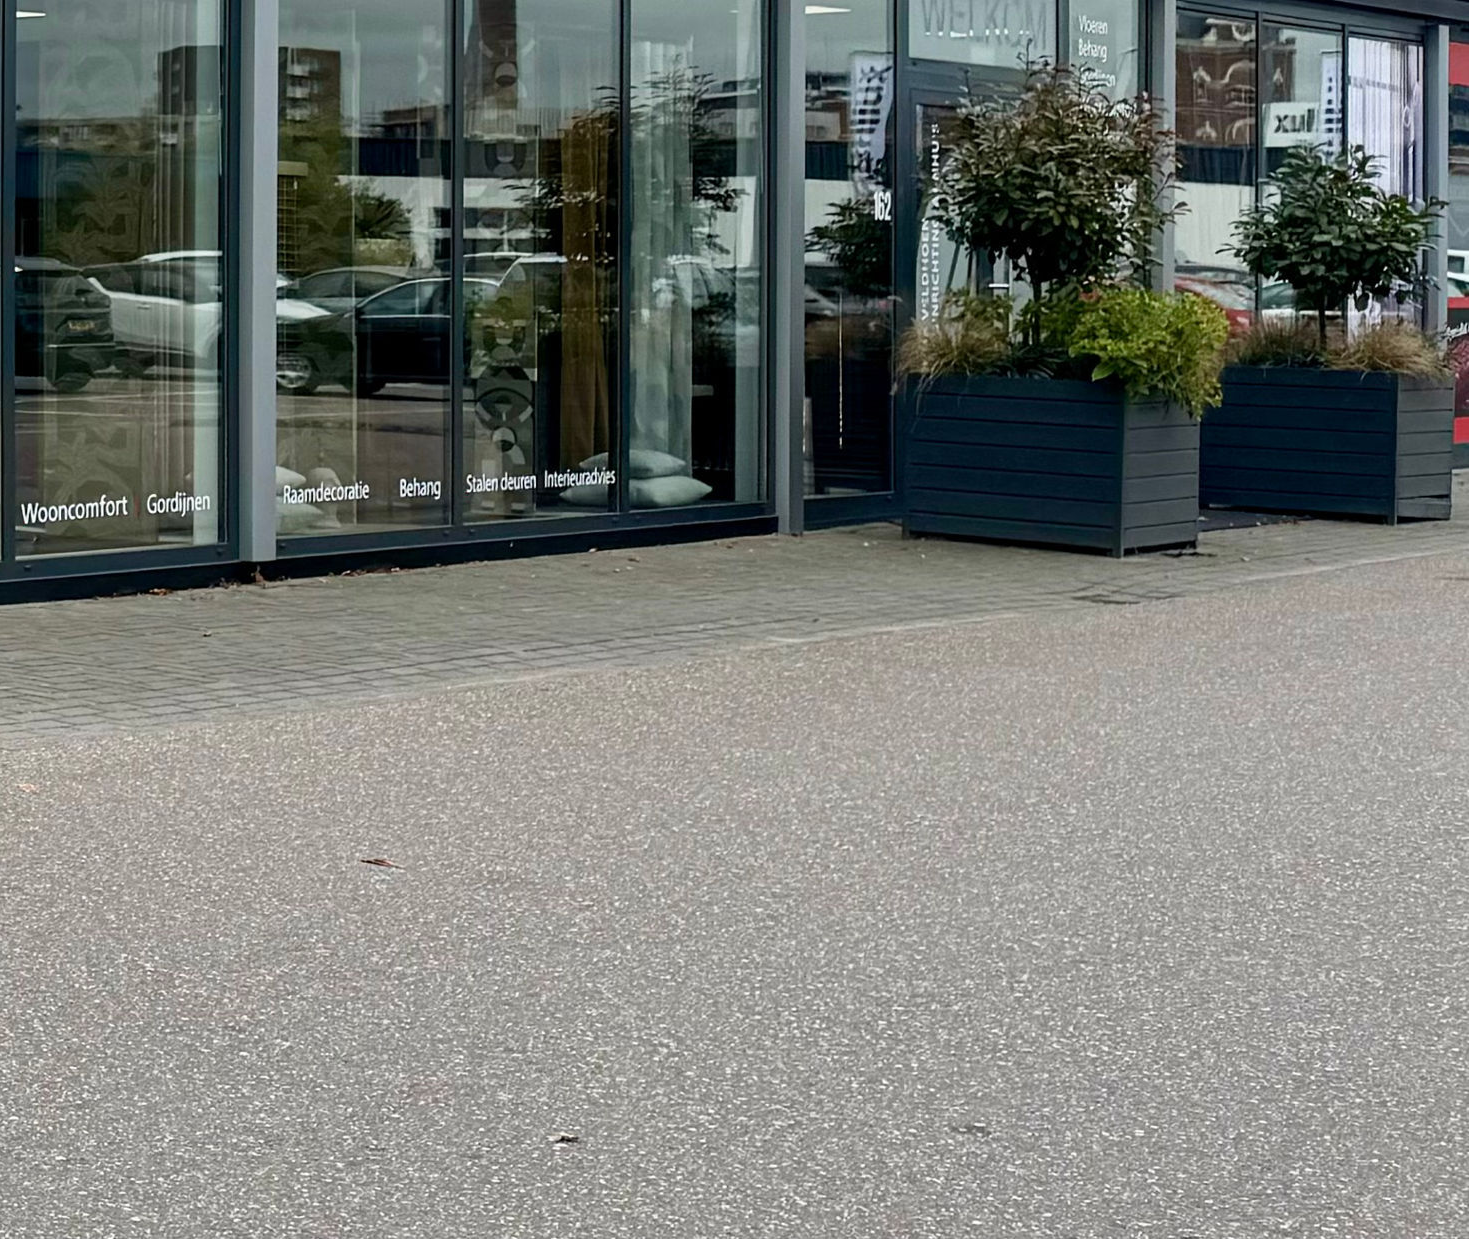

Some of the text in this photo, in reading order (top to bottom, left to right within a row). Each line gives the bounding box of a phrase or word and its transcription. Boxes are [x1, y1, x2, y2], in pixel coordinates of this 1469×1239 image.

[1078, 15, 1108, 35] Vloeren
[1078, 38, 1108, 62] Behang
[874, 191, 892, 222] 162
[282, 477, 442, 505] Raamdecoratie Behang
[466, 466, 616, 494] Stalen deuren Interieuradvies
[20, 491, 211, 525] Wooncomfort Gordijnen
